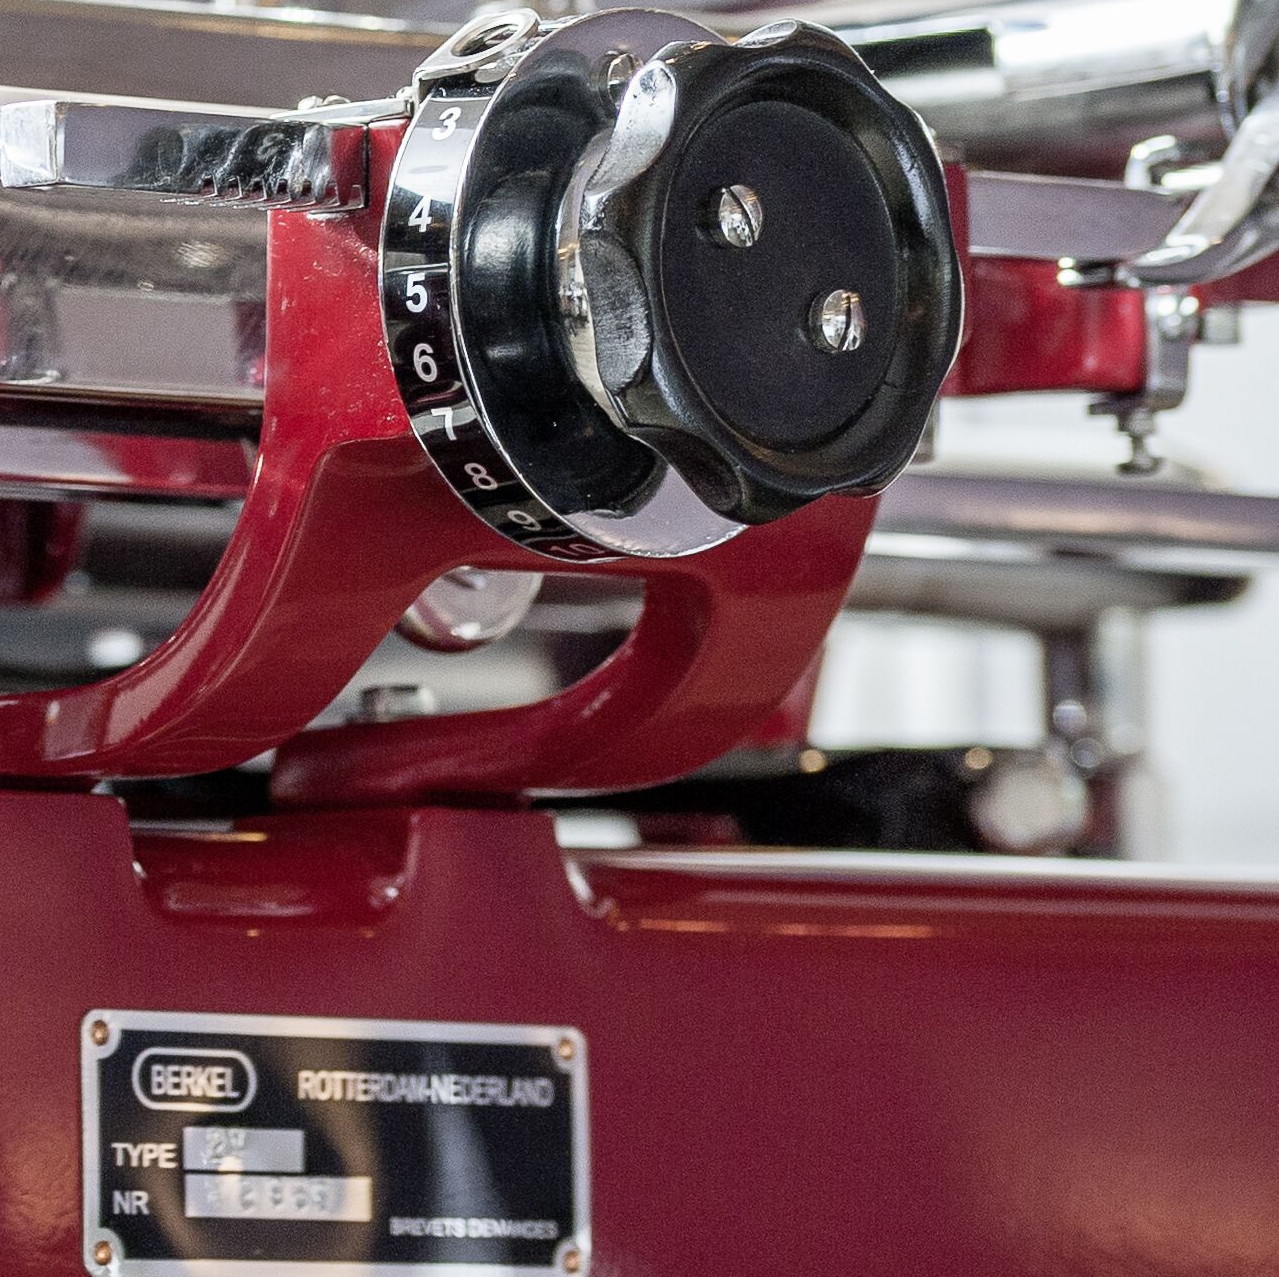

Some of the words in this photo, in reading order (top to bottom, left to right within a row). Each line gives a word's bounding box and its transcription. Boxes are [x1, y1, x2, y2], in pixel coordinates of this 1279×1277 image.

[430, 105, 461, 141] 3
[407, 194, 432, 233] 4
[404, 272, 428, 313] 5
[412, 342, 438, 383] 6
[430, 406, 458, 442] 7
[463, 461, 498, 492] 8
[507, 508, 543, 533] 9
[547, 541, 600, 559] 10
[151, 1064, 240, 1098] BERKEL
[111, 1142, 178, 1169] TYPE
[112, 1189, 150, 1216] NR
